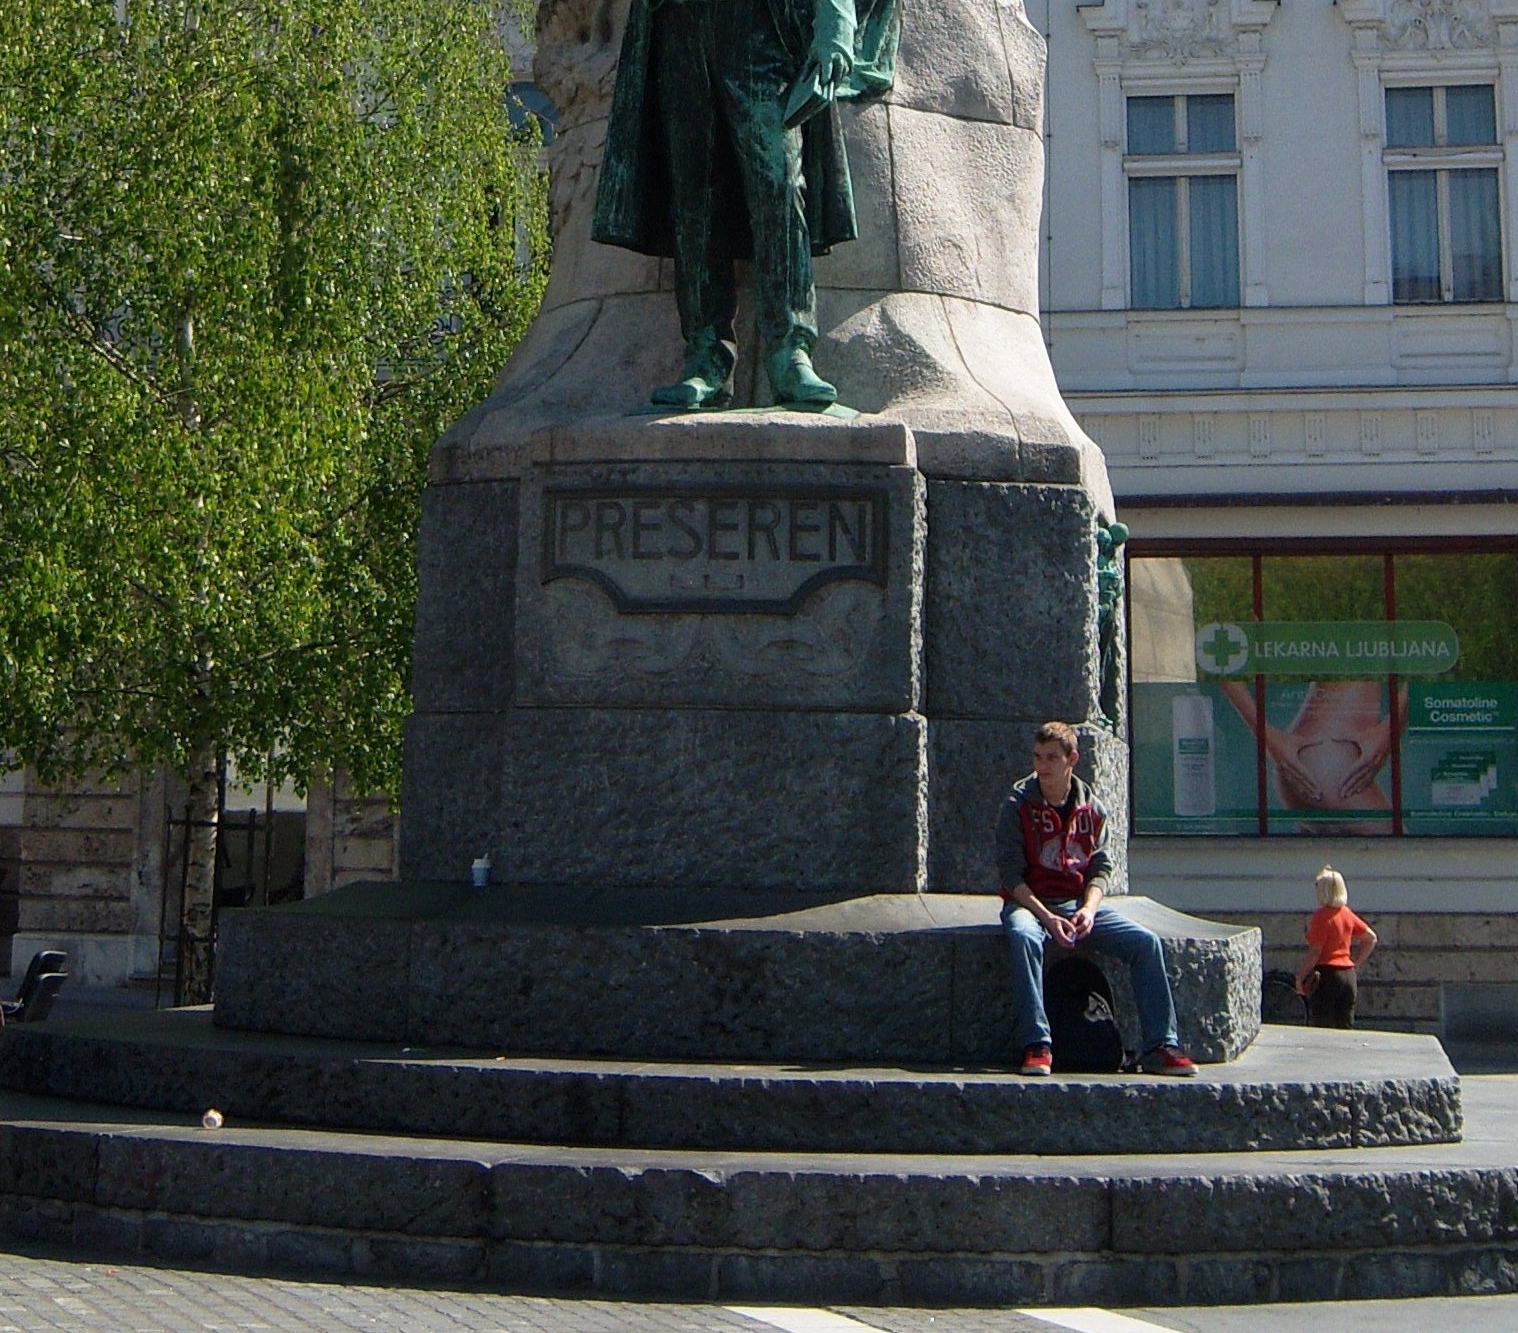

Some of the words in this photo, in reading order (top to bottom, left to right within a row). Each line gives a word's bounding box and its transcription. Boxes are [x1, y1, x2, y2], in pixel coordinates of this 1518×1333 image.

[1254, 640, 1340, 658] LEKARNA
[1346, 640, 1451, 657] LJUBLJANA
[1424, 696, 1498, 709] Somatoline
